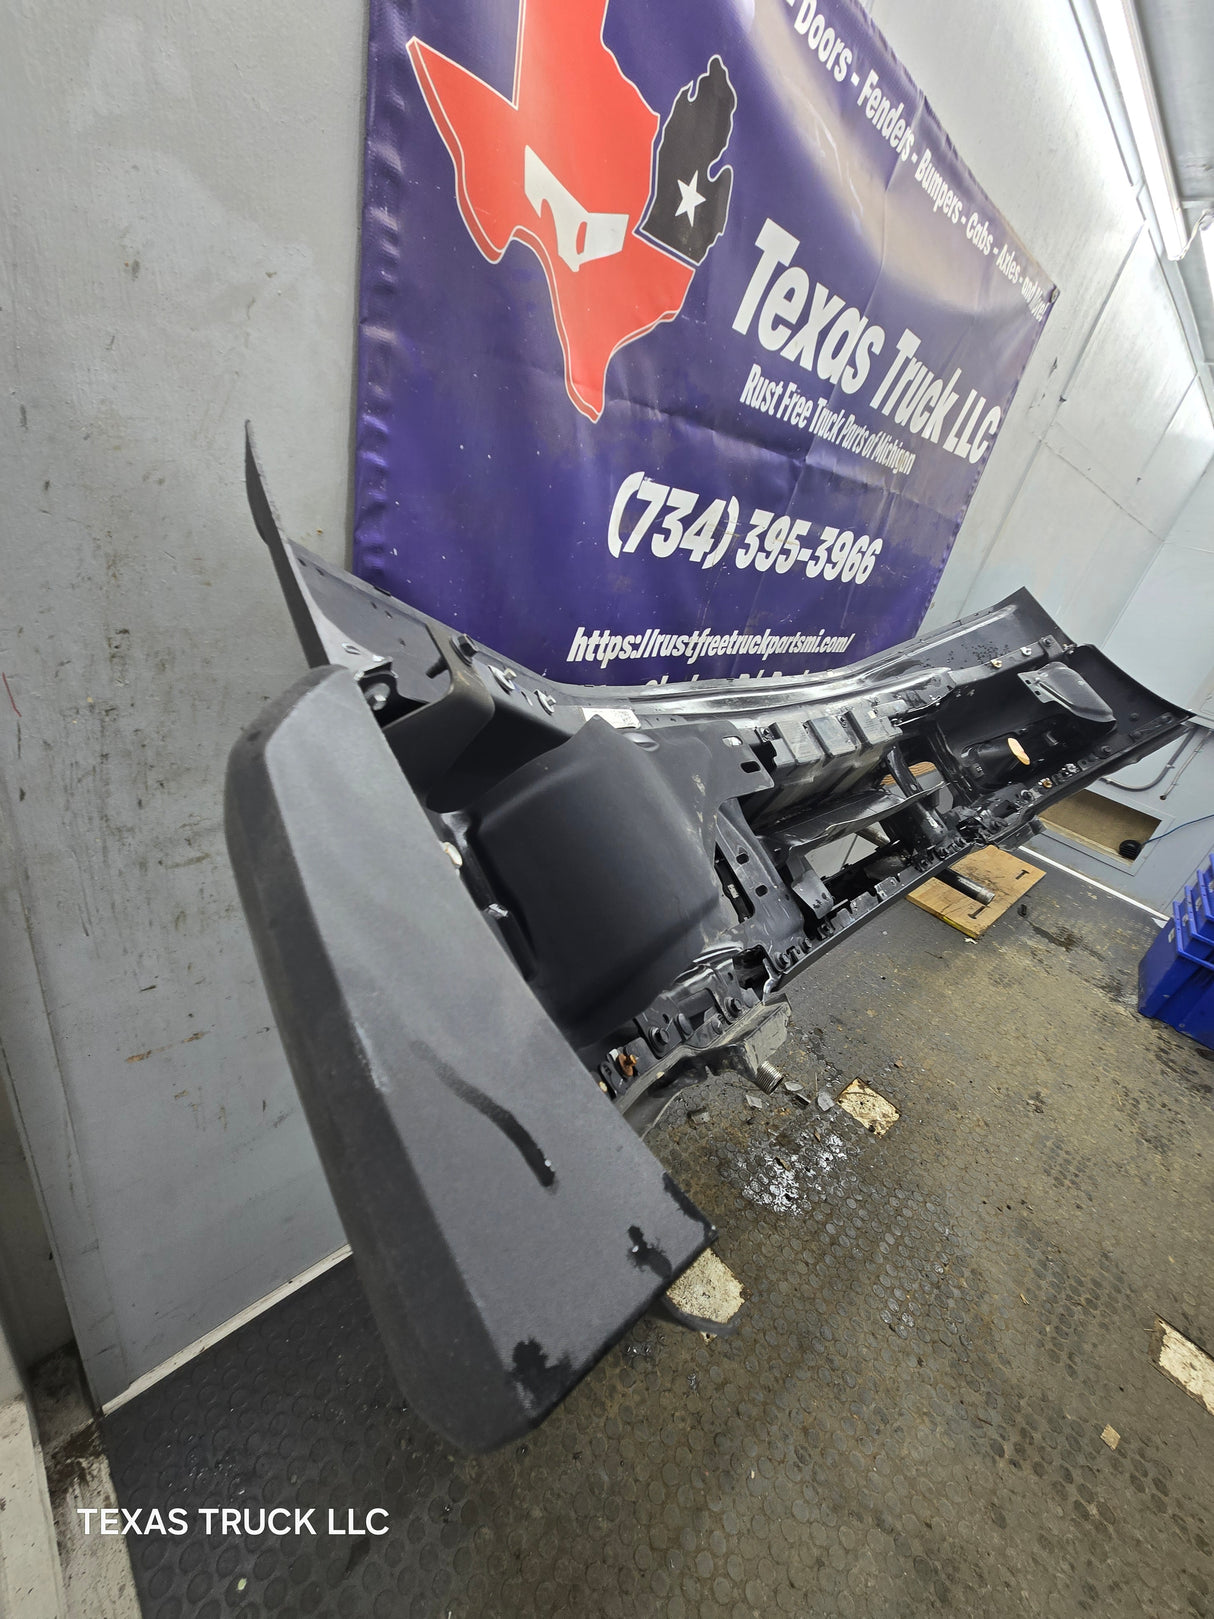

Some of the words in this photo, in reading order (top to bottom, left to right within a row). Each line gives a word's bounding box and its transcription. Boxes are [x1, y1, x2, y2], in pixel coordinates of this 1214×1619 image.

[794, 0, 852, 82] Doors
[857, 69, 915, 163] Fenders
[914, 149, 963, 223] Bumpers
[966, 212, 994, 255] Cabs
[996, 243, 1021, 284] Axles
[732, 218, 886, 394] Texas
[869, 328, 960, 444] Truck
[942, 389, 1002, 464] LLC
[740, 363, 784, 416] Rust
[776, 382, 814, 429] Free
[808, 397, 846, 443] Truck
[836, 414, 870, 454] Parts
[862, 431, 884, 458] of
[871, 432, 917, 475] Michigan
[608, 471, 740, 569] (734)
[735, 509, 884, 584] 395-3966
[566, 626, 855, 669] https://rustfreetruckpartsmi.com/
